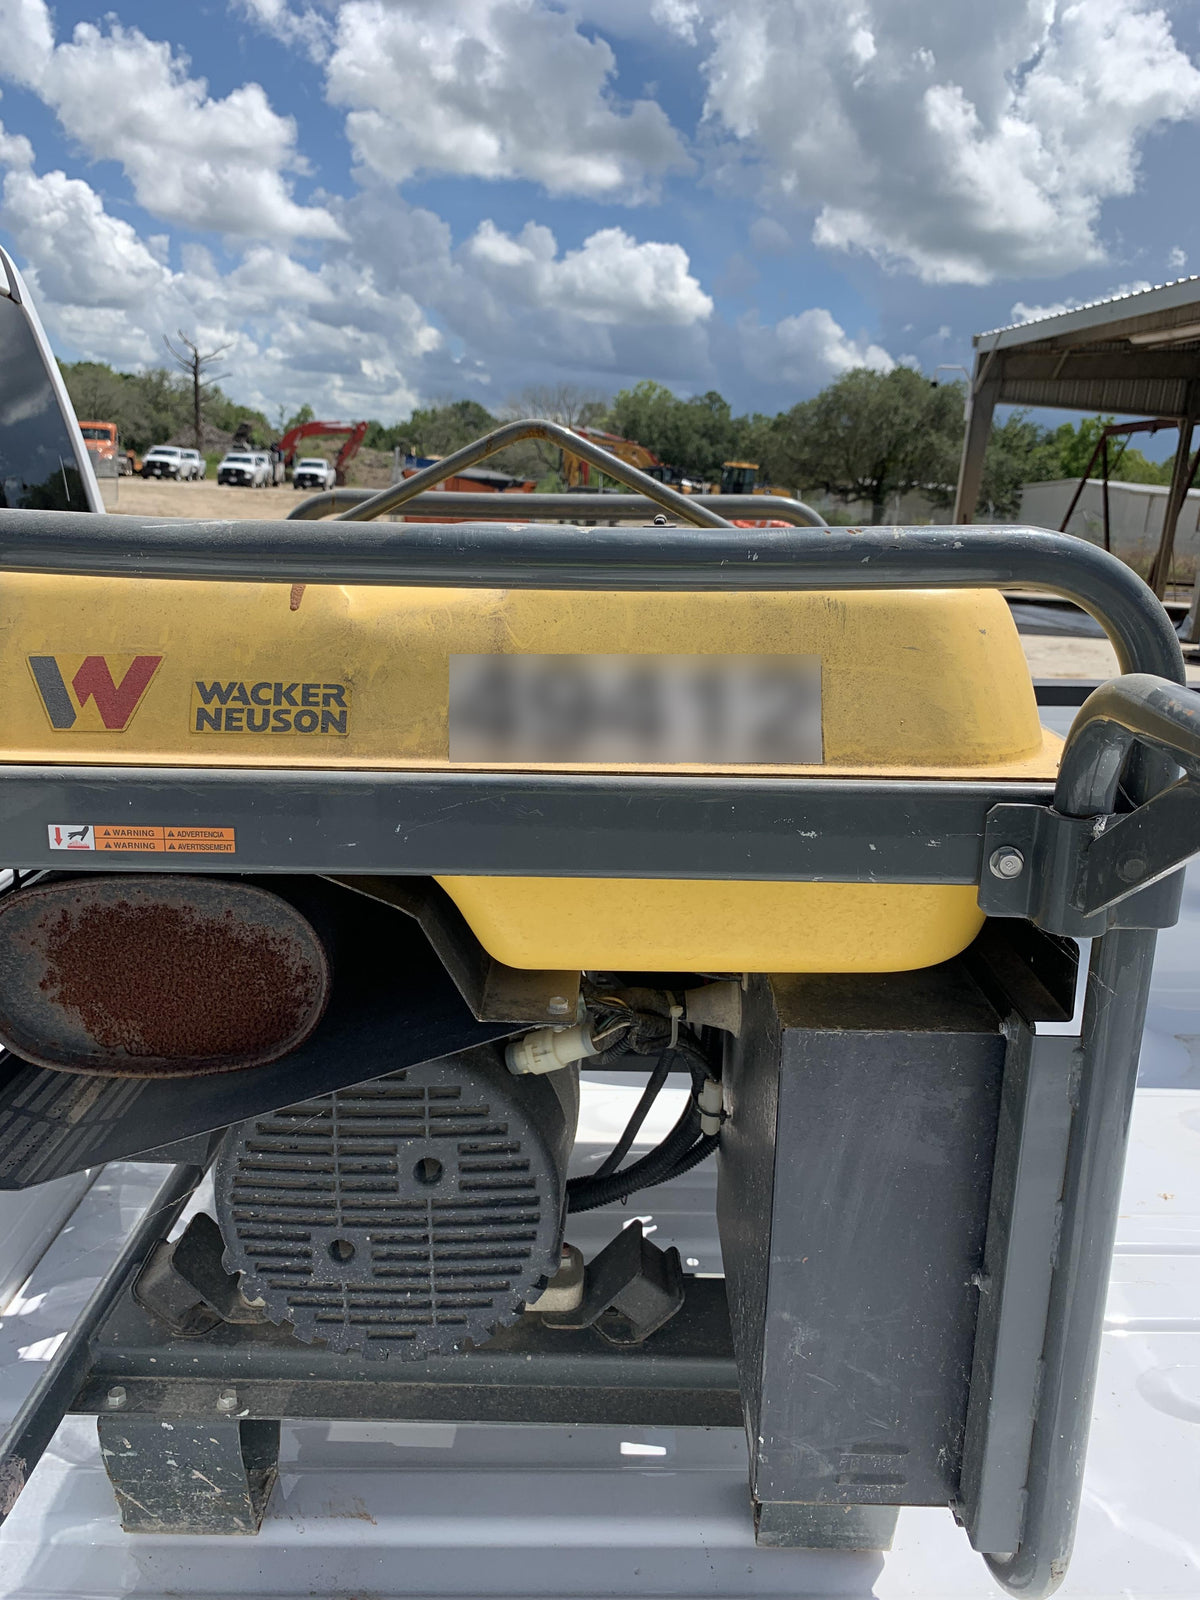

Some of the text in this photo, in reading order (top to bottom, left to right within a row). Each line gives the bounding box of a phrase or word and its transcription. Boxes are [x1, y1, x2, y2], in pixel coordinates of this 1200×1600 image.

[195, 681, 347, 707] WACKER
[195, 707, 347, 733] NEUSON
[112, 829, 155, 837] WARNING
[113, 841, 155, 849] WARNING
[177, 843, 232, 851] AVERTISSEMENT
